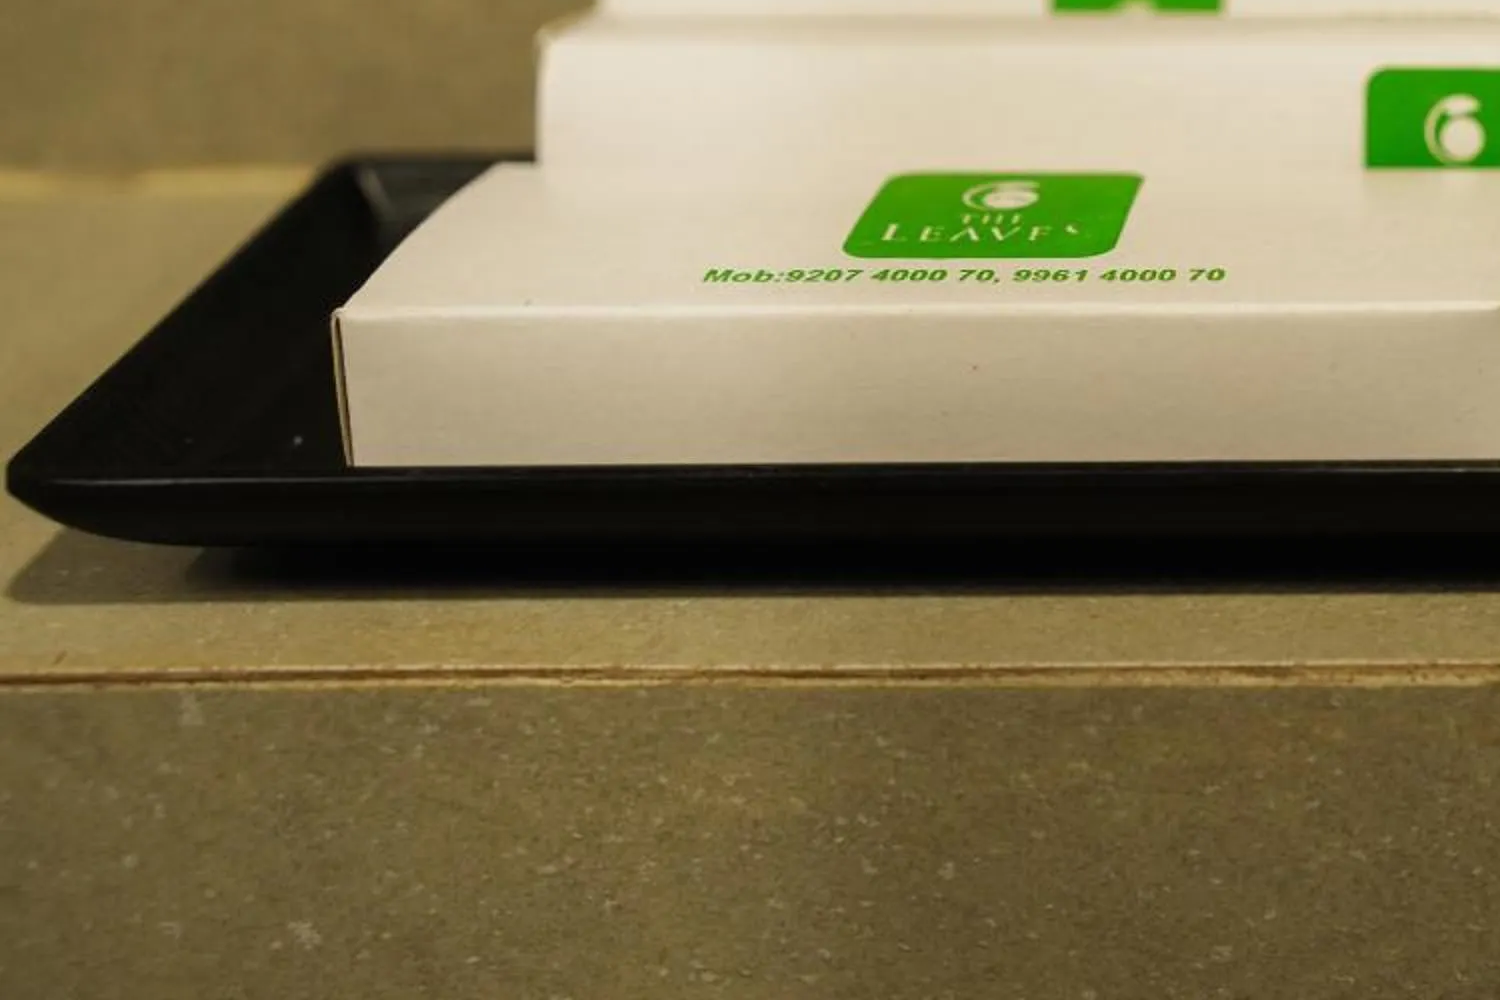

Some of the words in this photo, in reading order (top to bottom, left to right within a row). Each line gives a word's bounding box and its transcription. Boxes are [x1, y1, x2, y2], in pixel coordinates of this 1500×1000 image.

[702, 268, 864, 284] Mob:9207
[870, 268, 949, 283] 4000
[958, 268, 1001, 284] 70,
[1011, 268, 1089, 283] 9961
[1098, 268, 1177, 283] 4000
[1187, 268, 1227, 283] 70
